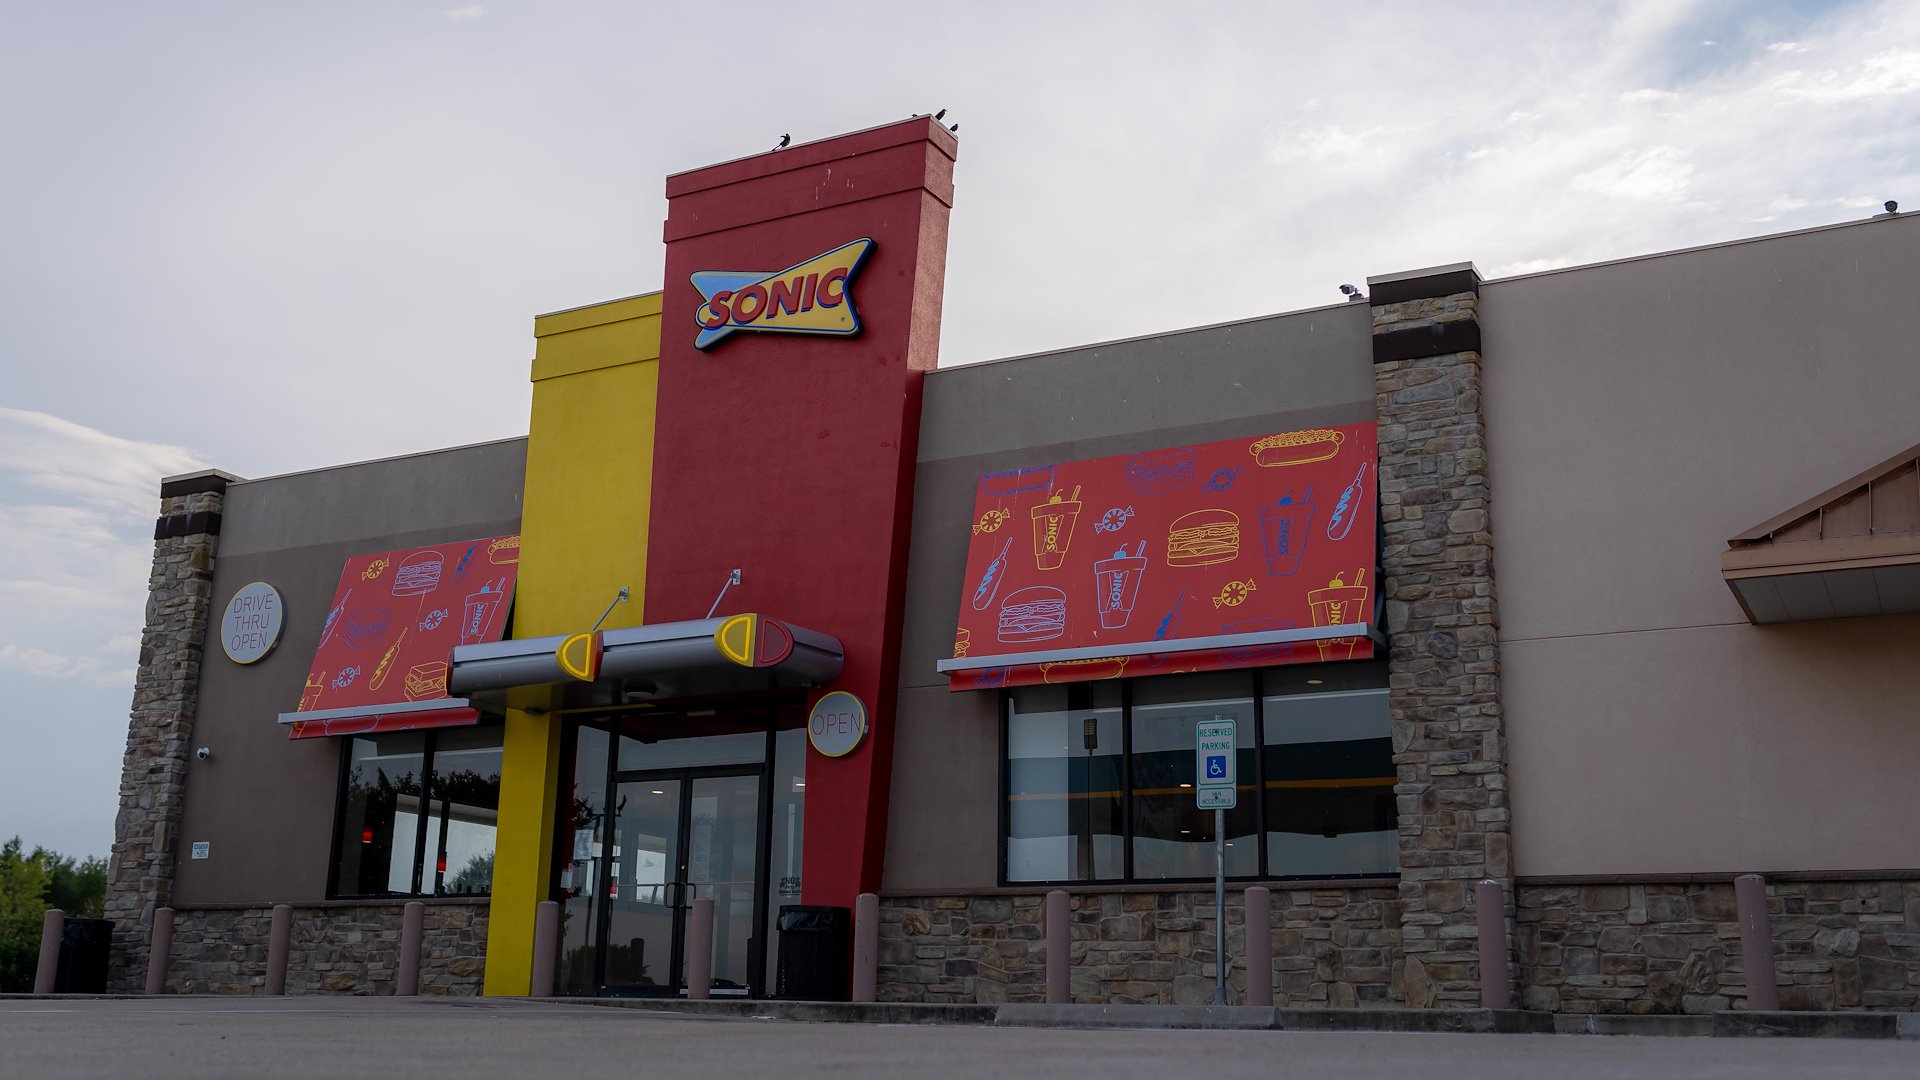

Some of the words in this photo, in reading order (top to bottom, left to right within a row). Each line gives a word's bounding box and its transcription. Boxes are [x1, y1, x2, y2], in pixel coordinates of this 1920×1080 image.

[703, 267, 848, 330] SONIC
[1046, 515, 1059, 552] SONIC
[1279, 519, 1289, 555] SONIC
[1111, 571, 1123, 609] SONIC
[233, 593, 274, 613] DRIVE
[233, 613, 270, 632] THRU
[470, 603, 484, 635] SONIC
[231, 632, 268, 651] OPEN
[812, 711, 861, 736] OPEN
[1200, 728, 1232, 737] RESERVED
[1202, 742, 1230, 750] PARKING
